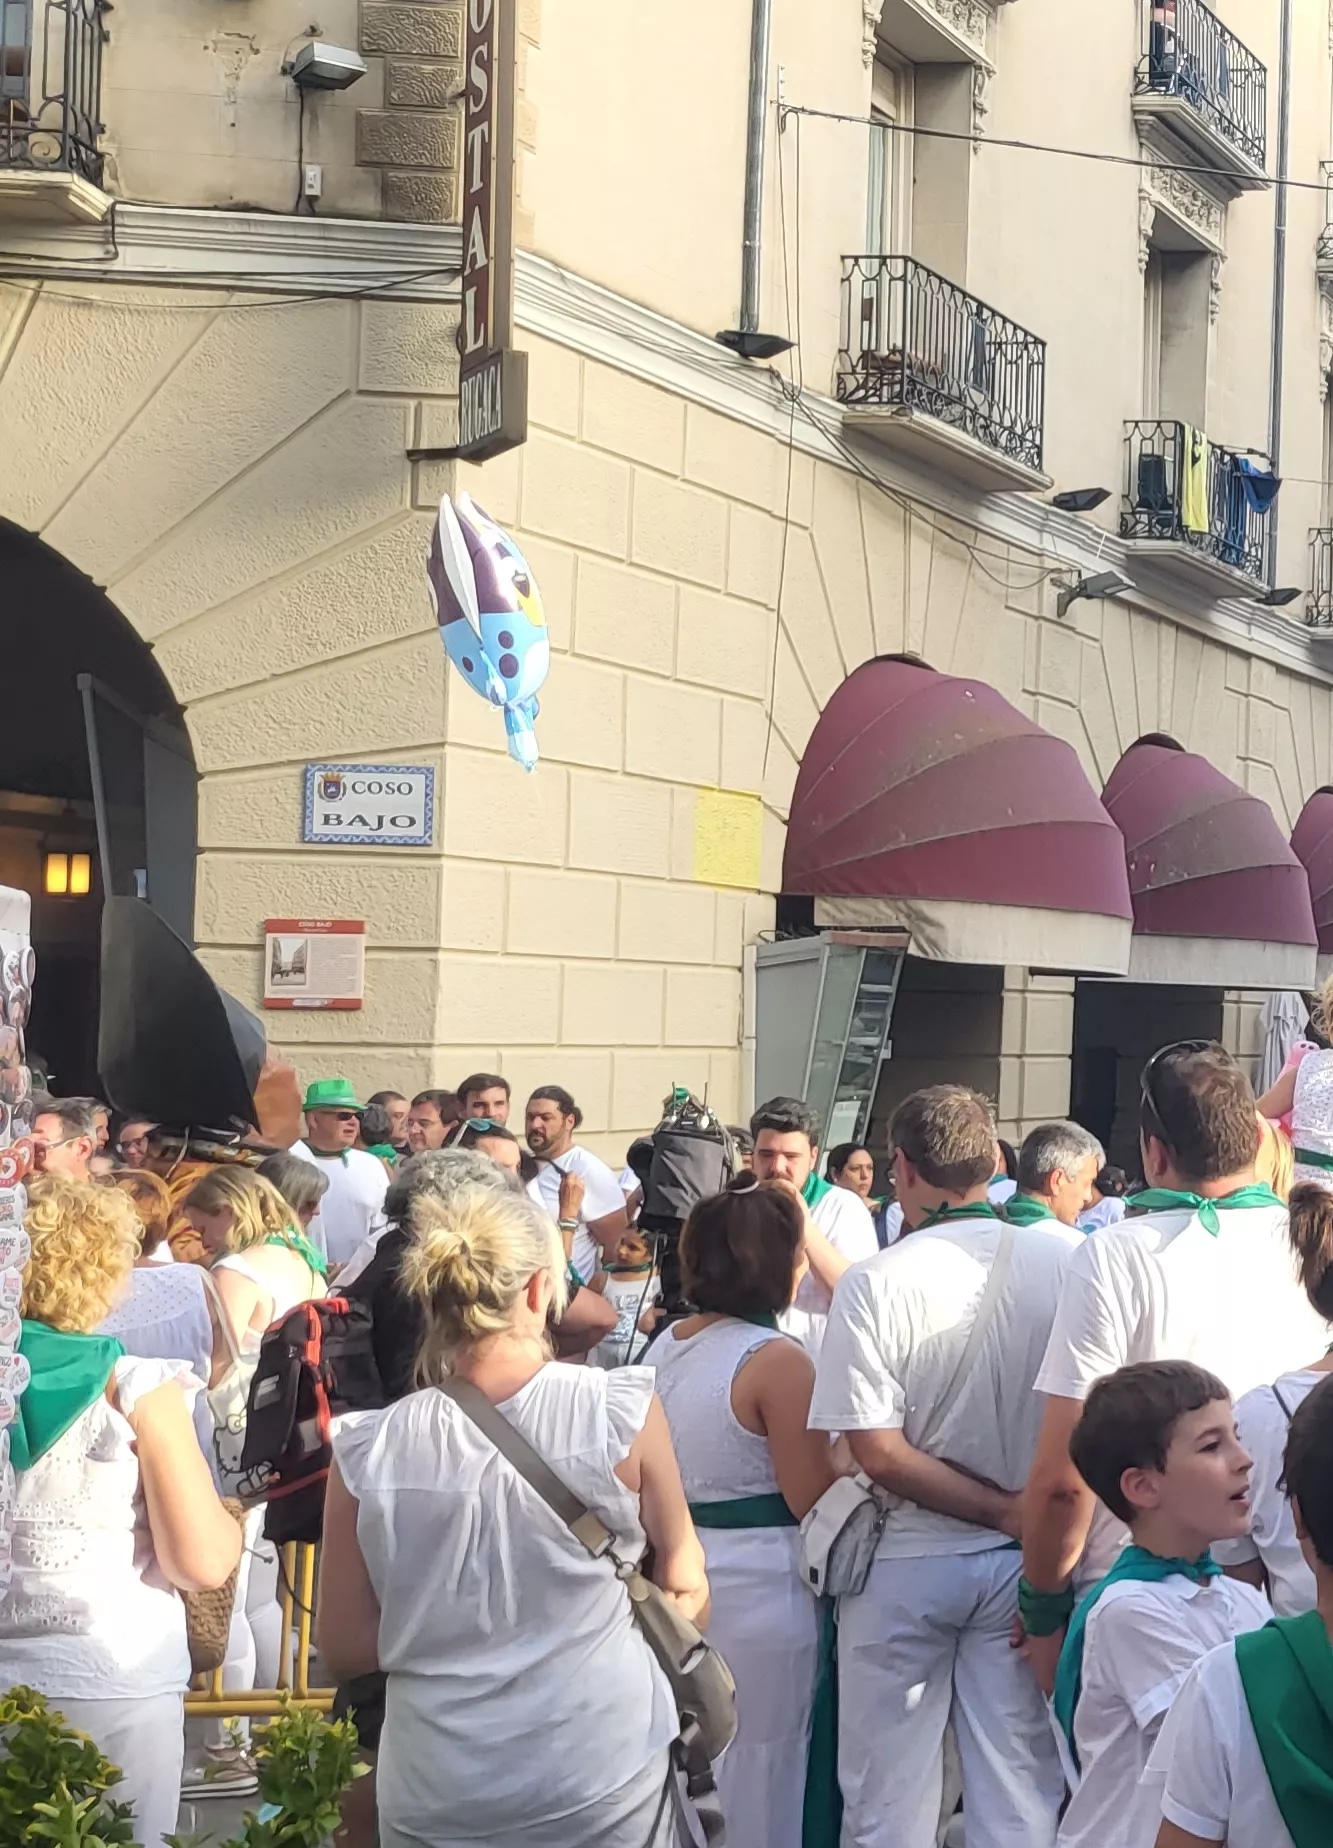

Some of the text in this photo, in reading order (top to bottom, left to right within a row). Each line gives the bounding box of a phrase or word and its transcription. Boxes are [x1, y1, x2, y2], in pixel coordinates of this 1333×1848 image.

[460, 362, 501, 447] RUGACA
[351, 780, 413, 796] COSO
[321, 813, 417, 832] BAJO
